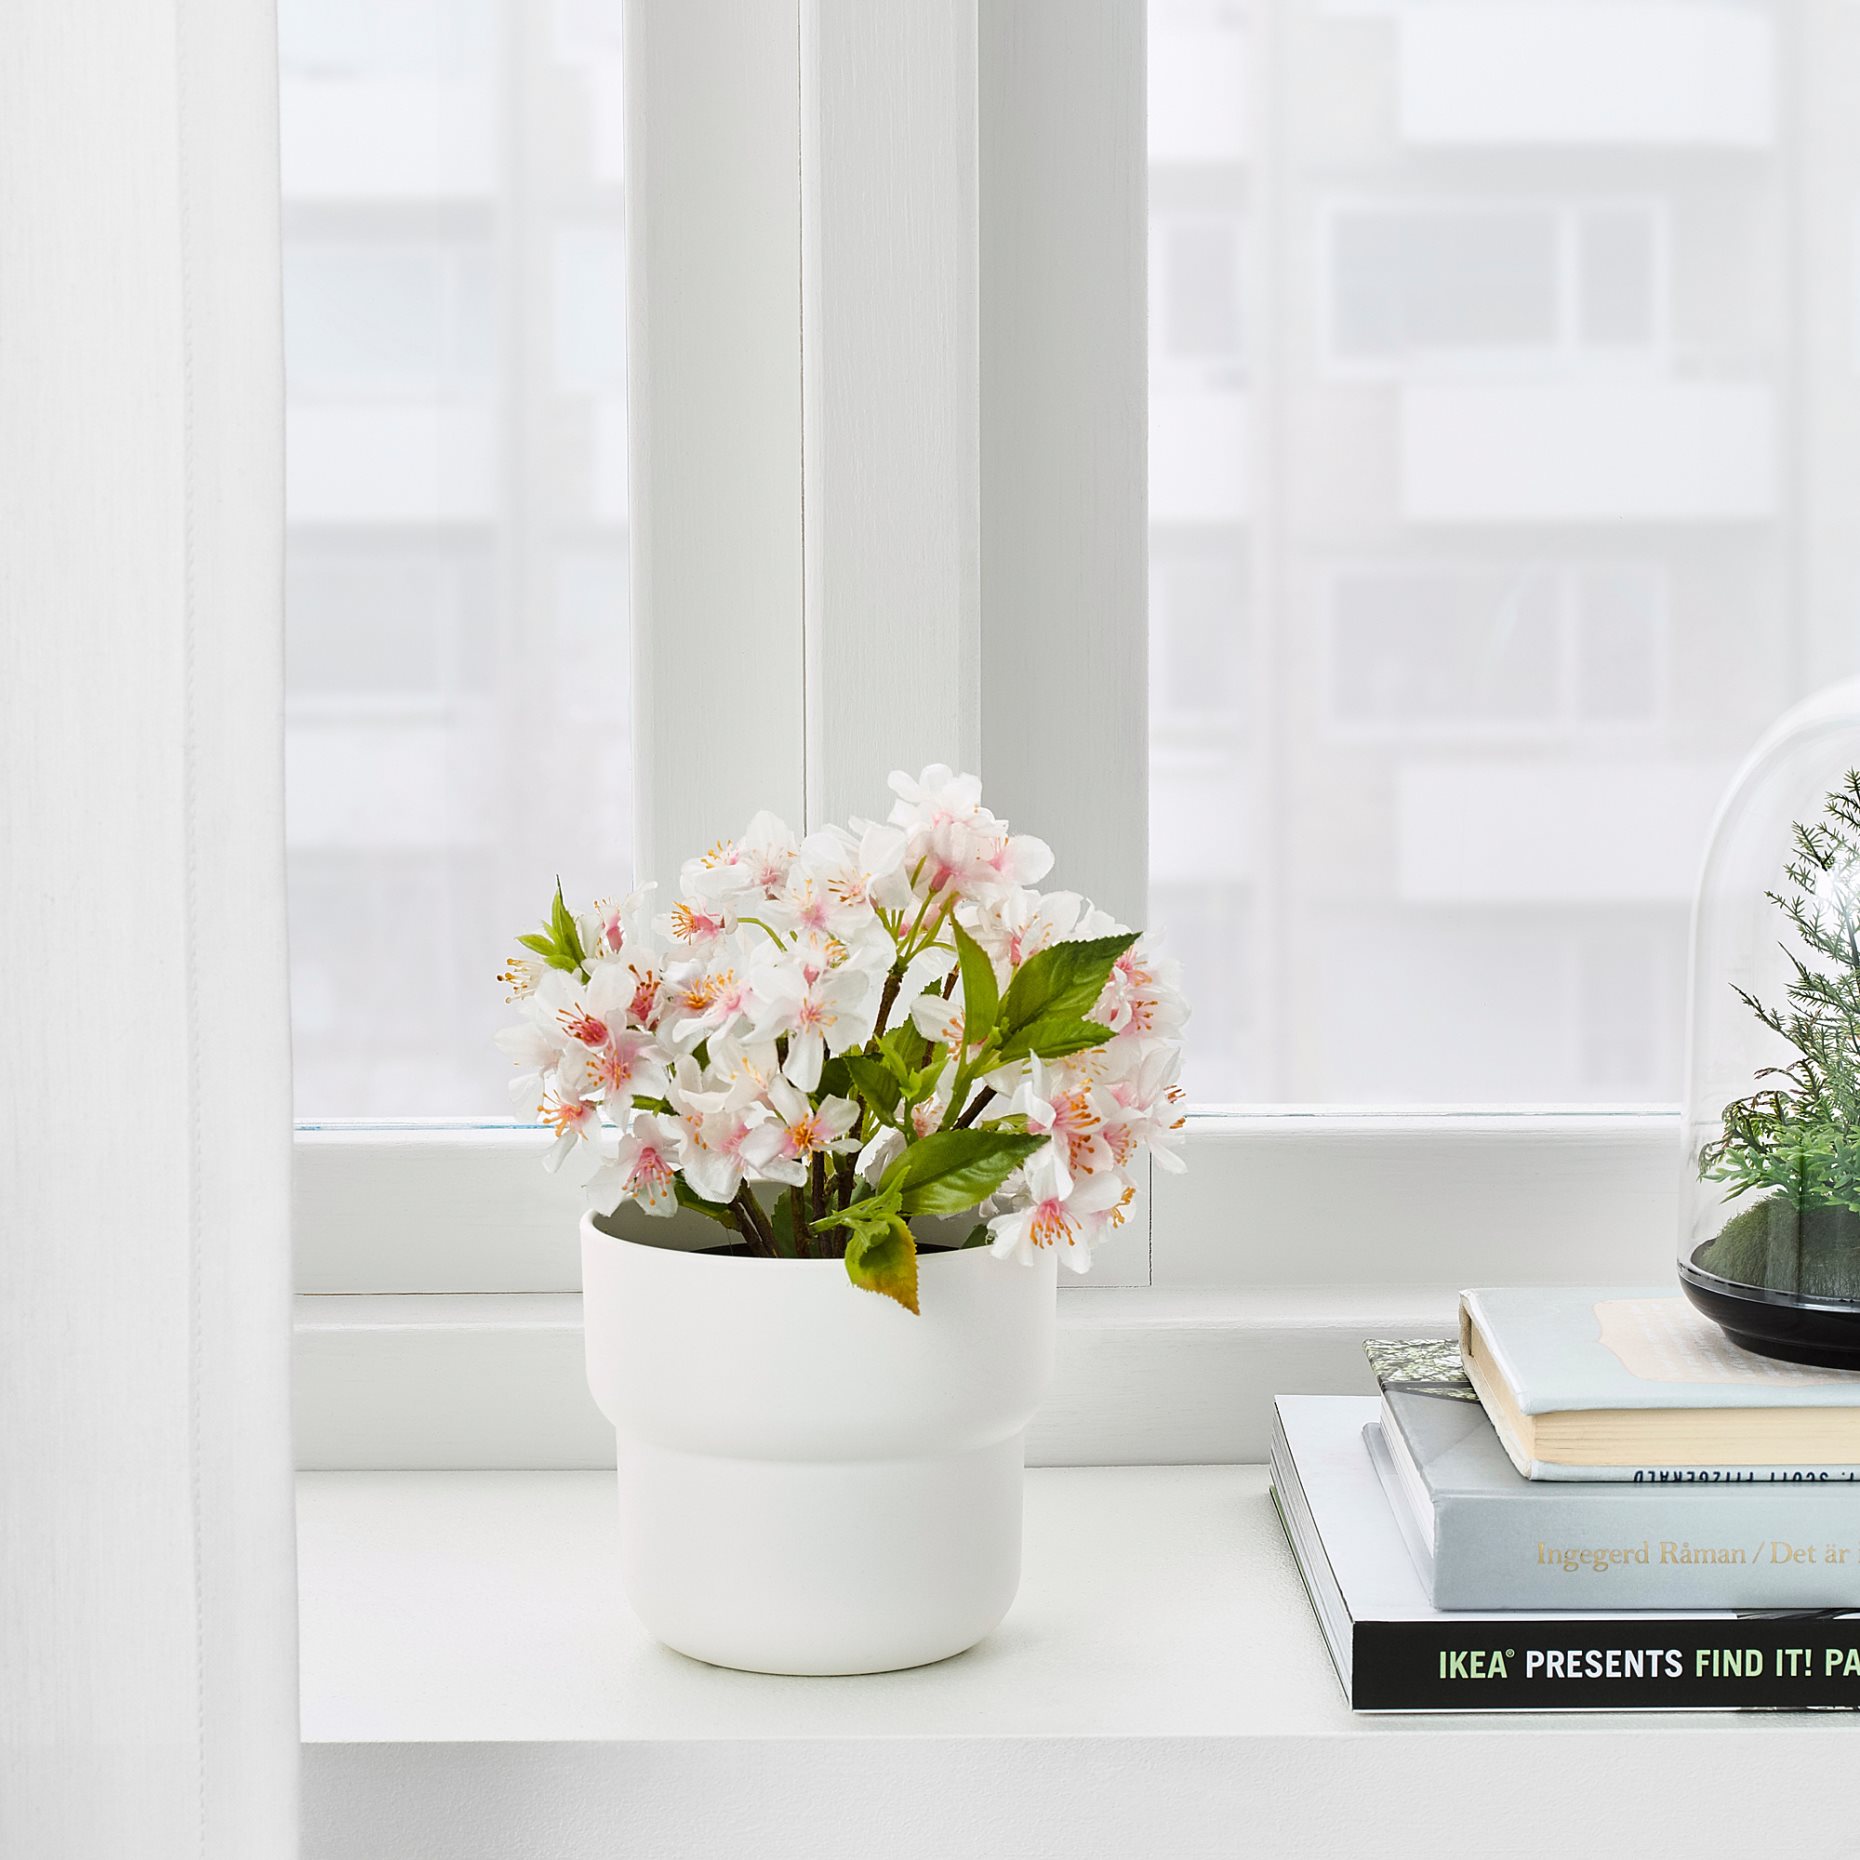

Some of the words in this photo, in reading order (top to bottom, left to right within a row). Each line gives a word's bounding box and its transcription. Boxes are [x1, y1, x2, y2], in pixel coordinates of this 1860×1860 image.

[1537, 1541, 1650, 1573] Ingegerd
[1659, 1541, 1747, 1565] Råman
[1770, 1541, 1817, 1564] Det
[1825, 1541, 1850, 1564] är
[1526, 1649, 1683, 1679] PRESENTS
[1696, 1649, 1763, 1677] FIND
[1775, 1649, 1812, 1677] IT!
